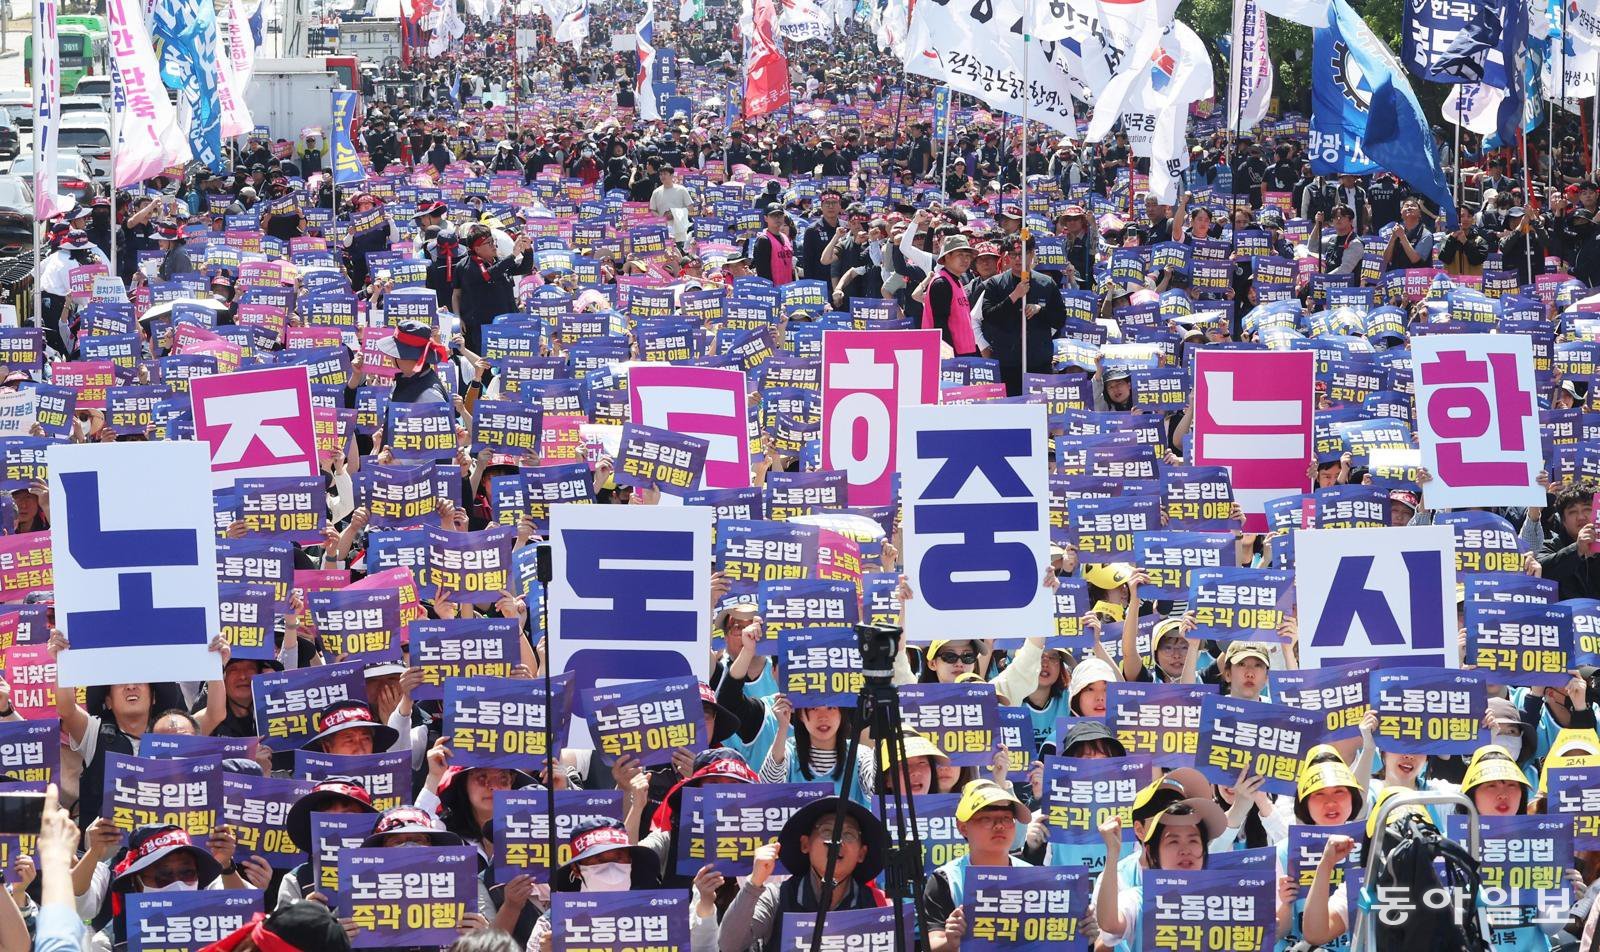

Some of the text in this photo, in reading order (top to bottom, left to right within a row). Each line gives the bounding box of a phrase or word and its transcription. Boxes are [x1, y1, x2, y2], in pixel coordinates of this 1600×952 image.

[1237, 238, 1268, 247] 노동입법
[1193, 268, 1227, 277] 노동입법
[1258, 264, 1292, 277] 노동입법
[1485, 278, 1518, 288] 노동입법
[250, 295, 286, 305] 노동입법
[312, 303, 351, 314] 노동입법
[632, 297, 669, 308] 노동입법
[684, 298, 721, 311] 노동입법
[1453, 300, 1492, 312] 노동입법
[728, 307, 770, 319] 노동입법
[562, 322, 602, 333] 노동입법
[0, 338, 33, 350] 동입법
[86, 344, 132, 357] 노동입법
[289, 338, 314, 348] 되찾은
[646, 337, 690, 351] 노동입법
[12, 351, 36, 363] 이행!
[668, 348, 691, 360] 이행!
[56, 374, 83, 386] 되찾은
[507, 366, 554, 380] 노동입법
[767, 368, 816, 381] 노동입법
[1332, 374, 1380, 390] 노동입법
[1137, 378, 1181, 392] 노동입법
[1138, 391, 1186, 404] 즉각 이행!
[394, 416, 450, 432] 노동입법
[479, 413, 533, 432] 노동입법
[1421, 351, 1532, 487] 한
[393, 434, 456, 450] 즉각 이행!
[478, 429, 536, 448] 즉각 이행!
[626, 439, 693, 469] 노동입법
[1093, 461, 1154, 477] 노동입법
[372, 479, 431, 500] 노동입법
[772, 487, 836, 504] 노동입법
[1167, 482, 1230, 501] 노동입법
[243, 492, 312, 512] 노동입법
[370, 496, 437, 518] 즉각 이행!
[1167, 502, 1200, 520] 즉각
[1322, 501, 1382, 521] 노동입법
[244, 513, 318, 532] 즉각 이행!
[914, 429, 1039, 610] 중
[1077, 513, 1147, 532] 노동입법
[725, 538, 803, 563] 노동입법
[1078, 534, 1112, 552] 즉각
[59, 471, 208, 650] 노
[429, 545, 501, 569] 노동입법
[1144, 548, 1220, 567] 노동입법
[1484, 552, 1525, 572] 이행!
[430, 567, 508, 593] 즉각 이행!
[724, 561, 761, 582] 즉각
[1146, 568, 1182, 588] 즉각
[1196, 584, 1277, 607] 노동입법
[766, 598, 844, 619] 노동입법
[1196, 606, 1234, 628] 즉각
[315, 608, 384, 630] 노동입법
[347, 630, 391, 654] 이행!
[1477, 622, 1559, 648] 노동입법
[419, 638, 503, 661] 노동입법
[787, 647, 863, 670] 노동입법
[1476, 648, 1567, 673] 즉각 이행!
[788, 672, 827, 694] 즉각
[14, 690, 44, 708] 다시
[1380, 690, 1471, 714] 노동입법
[454, 700, 546, 728] 노동입법
[596, 698, 686, 731] 노동입법
[900, 704, 983, 728] 노동입법
[1117, 704, 1202, 728] 노동입법
[268, 717, 308, 739] 즉각
[1213, 718, 1302, 756] 노동입법
[1379, 716, 1478, 741] 즉각 이행!
[453, 727, 497, 753] 즉각
[600, 723, 696, 757] 즉각 이행!
[946, 730, 992, 752] 이행!
[1566, 758, 1585, 766] 교사
[114, 778, 208, 807] 노동입법
[351, 872, 455, 899] 노동입법
[1509, 866, 1562, 889] 이행!
[974, 889, 1070, 914] 노동입법
[1155, 895, 1255, 921] 노동입법
[352, 903, 465, 931] 즉각 이행!
[140, 915, 243, 943] 노동입법
[565, 916, 668, 942] 노동입법
[972, 917, 1076, 941] 즉각 이행!
[1154, 925, 1264, 952] 즉각 이행!
